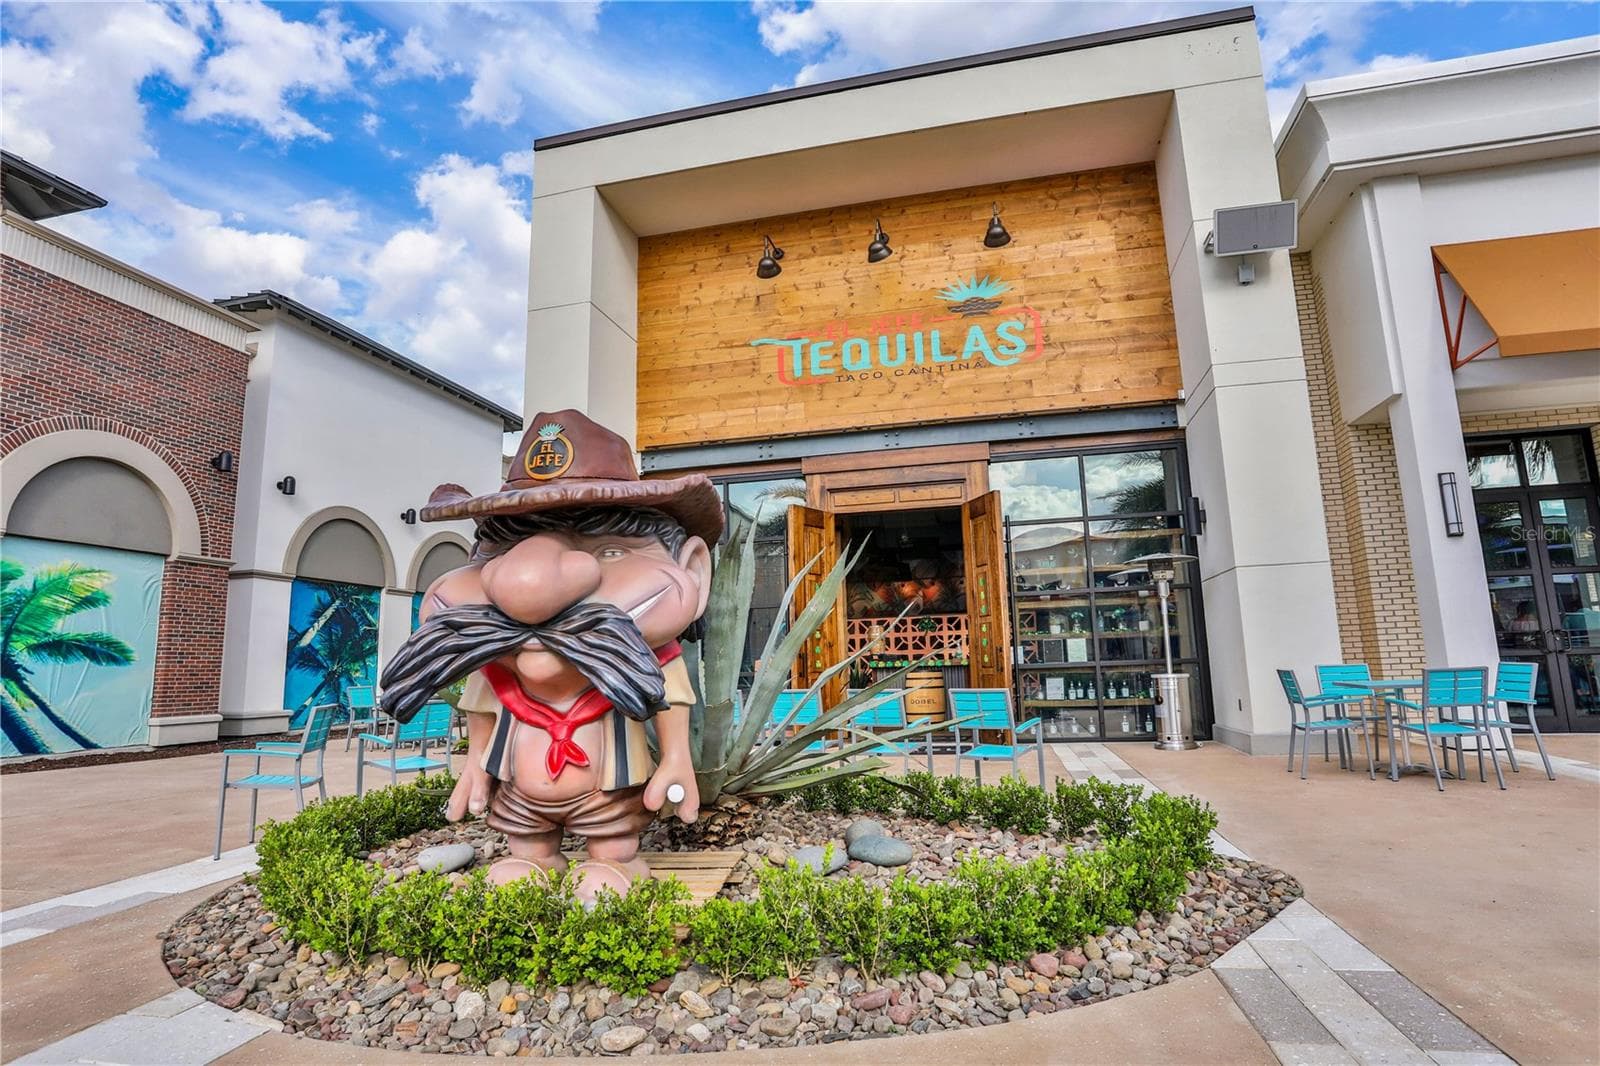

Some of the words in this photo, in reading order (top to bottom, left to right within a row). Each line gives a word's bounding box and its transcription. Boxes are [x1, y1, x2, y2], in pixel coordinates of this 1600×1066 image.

[826, 320, 853, 340] EL
[870, 312, 924, 334] JEFE
[751, 321, 1027, 378] TEQUILAS
[835, 370, 883, 383] TACO
[893, 360, 984, 377] CANTINA
[540, 440, 554, 453] EL
[529, 454, 563, 469] JEFE
